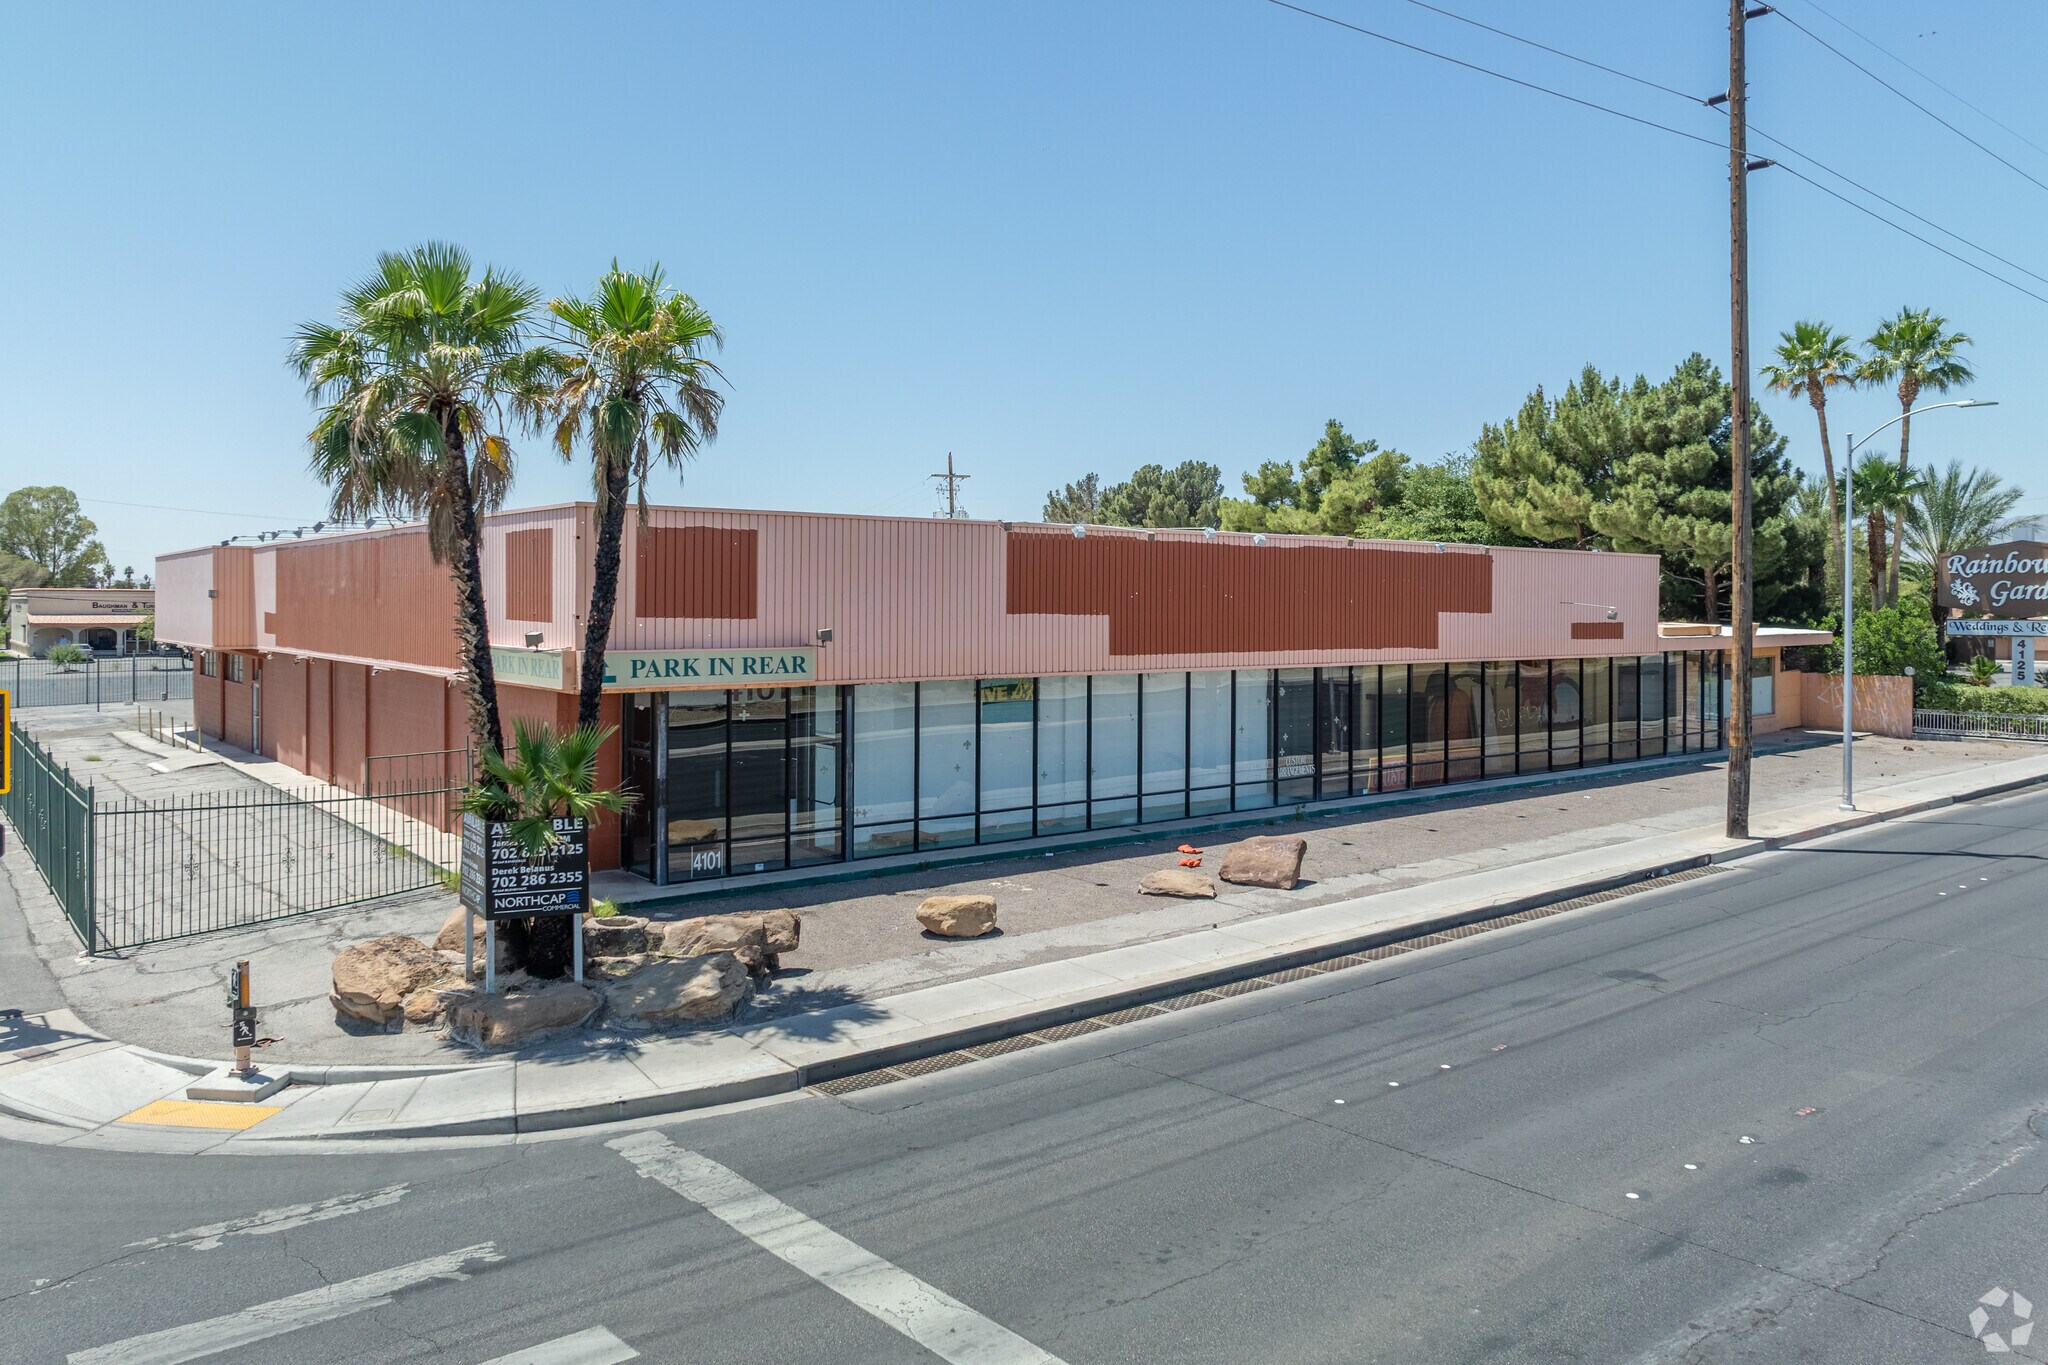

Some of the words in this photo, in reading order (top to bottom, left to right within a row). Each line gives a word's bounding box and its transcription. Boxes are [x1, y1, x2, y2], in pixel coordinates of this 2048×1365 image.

[1949, 621, 2009, 634] Weddings
[2012, 621, 2024, 633] &
[518, 656, 529, 675] IN
[530, 658, 560, 680] REAR
[630, 657, 701, 678] PARK
[708, 657, 735, 676] IN
[741, 656, 807, 675] REAR
[2016, 639, 2026, 680] 4125
[491, 847, 517, 860] 702
[521, 846, 547, 857] 85
[551, 843, 583, 856] 2125
[693, 850, 721, 871] 4101
[492, 866, 519, 876] Derek
[492, 876, 517, 888] 702
[521, 873, 547, 886] 286
[550, 871, 583, 884] 2355
[494, 893, 566, 909] NORTHCAP
[542, 903, 580, 912] COMMERCIAL
